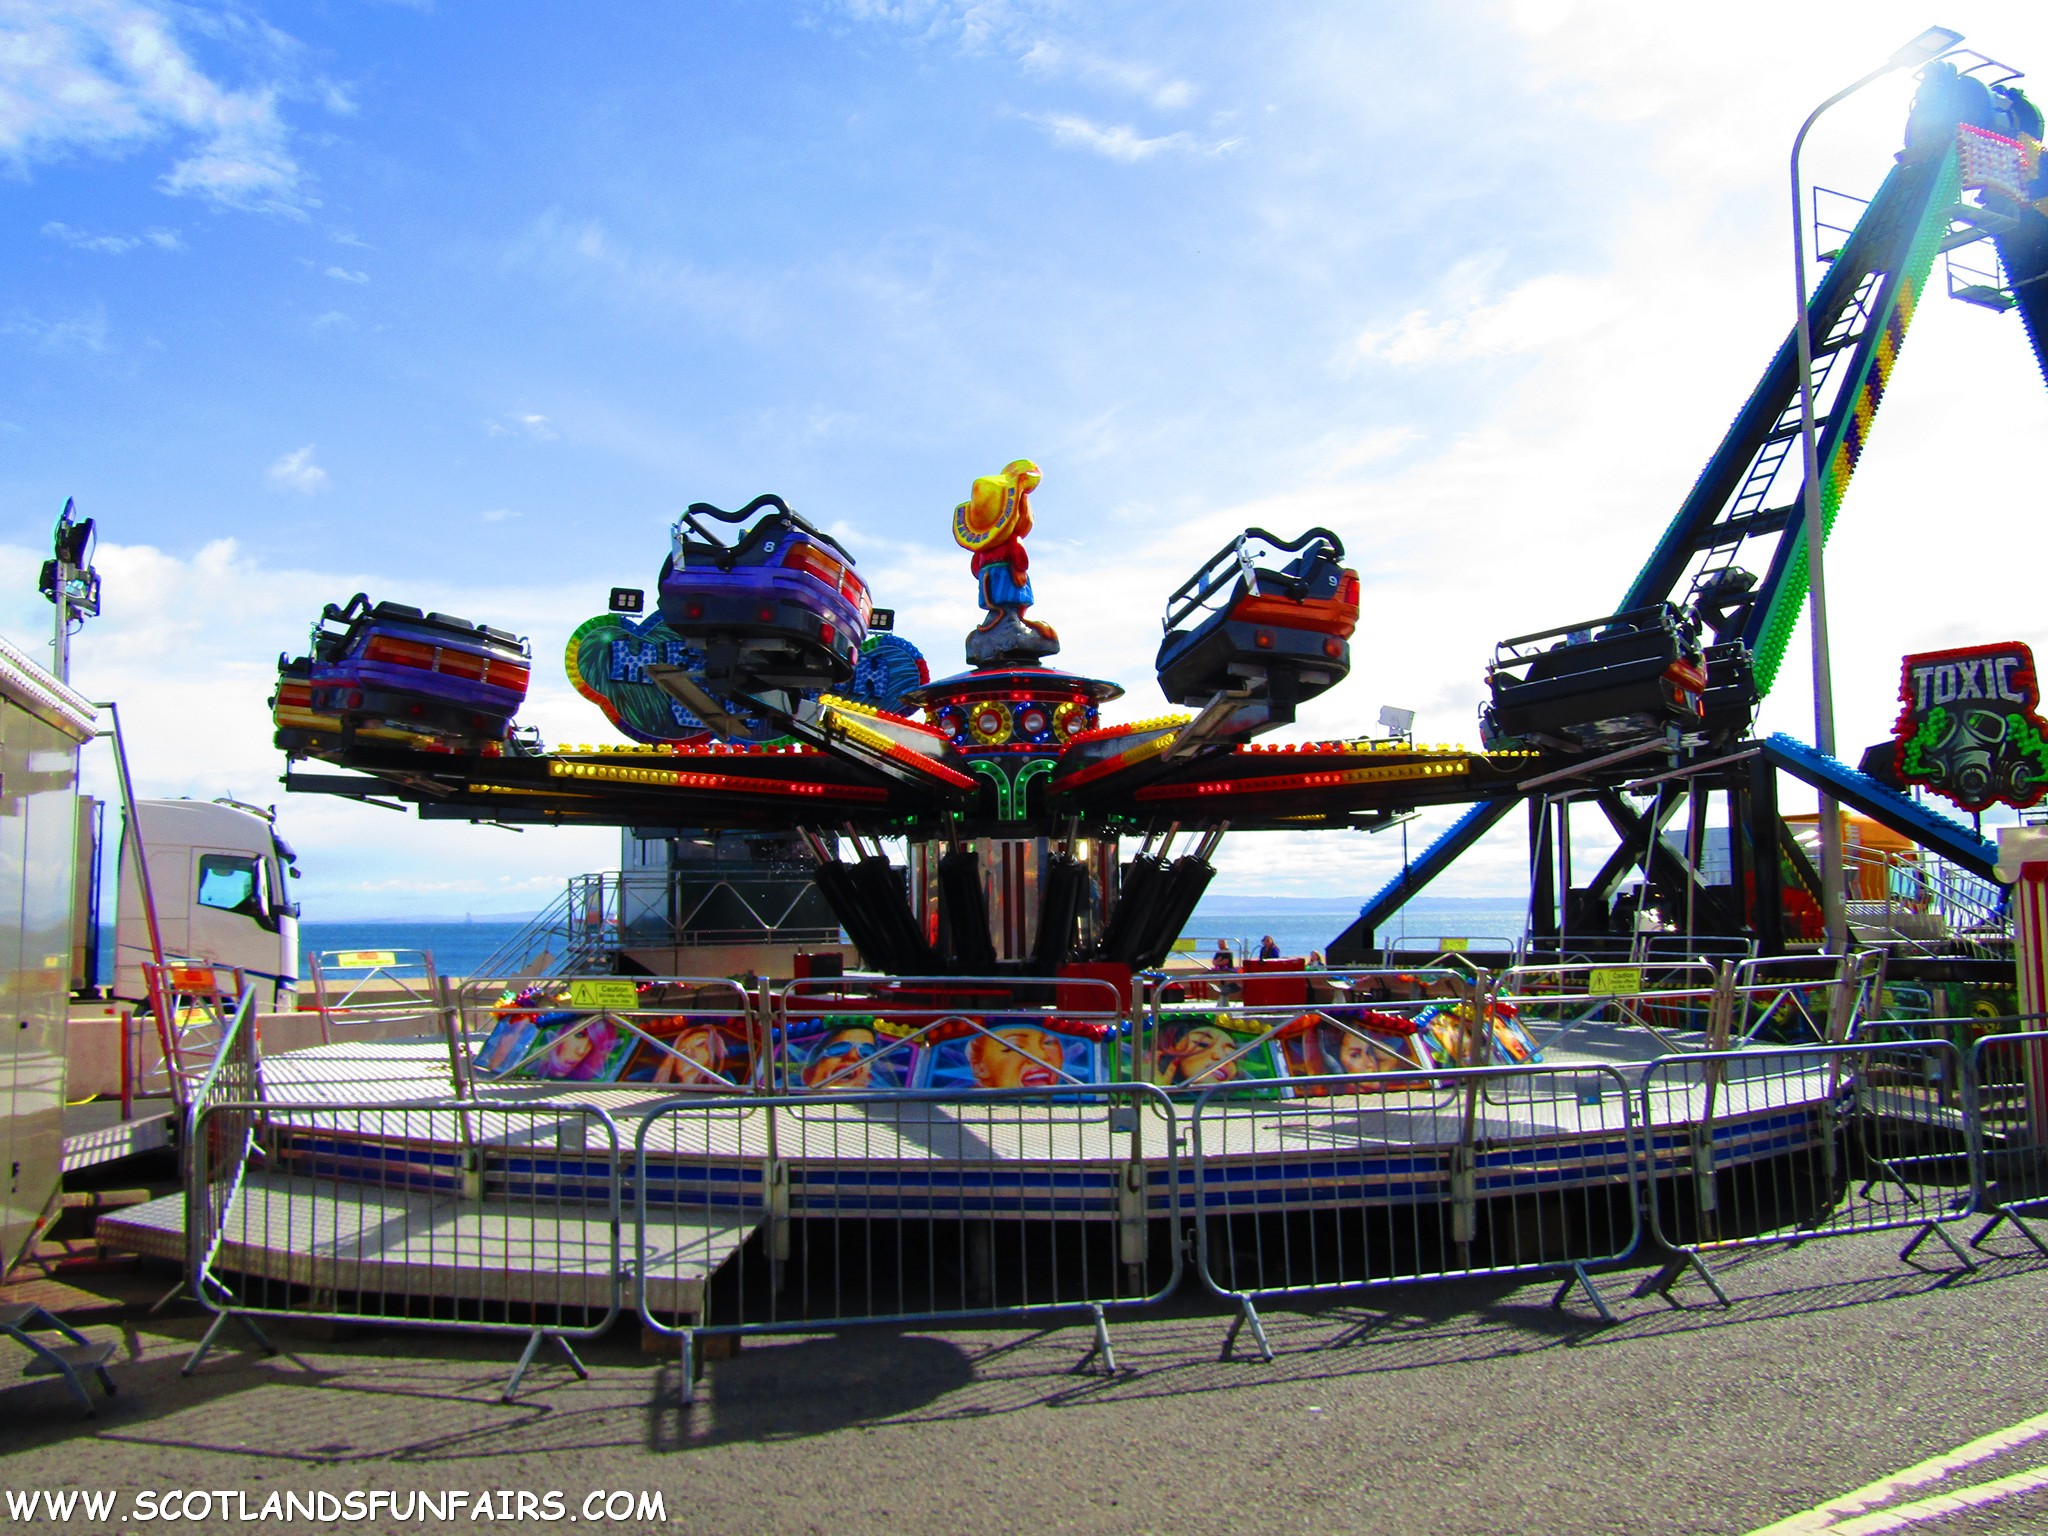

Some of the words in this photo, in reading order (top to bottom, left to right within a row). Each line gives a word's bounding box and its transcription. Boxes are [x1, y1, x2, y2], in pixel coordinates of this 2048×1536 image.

[957, 506, 990, 544] MEXICAN
[764, 541, 775, 553] 8
[1328, 575, 1338, 587] 9
[1912, 657, 2025, 712] TOXIC
[601, 985, 628, 993] Caution
